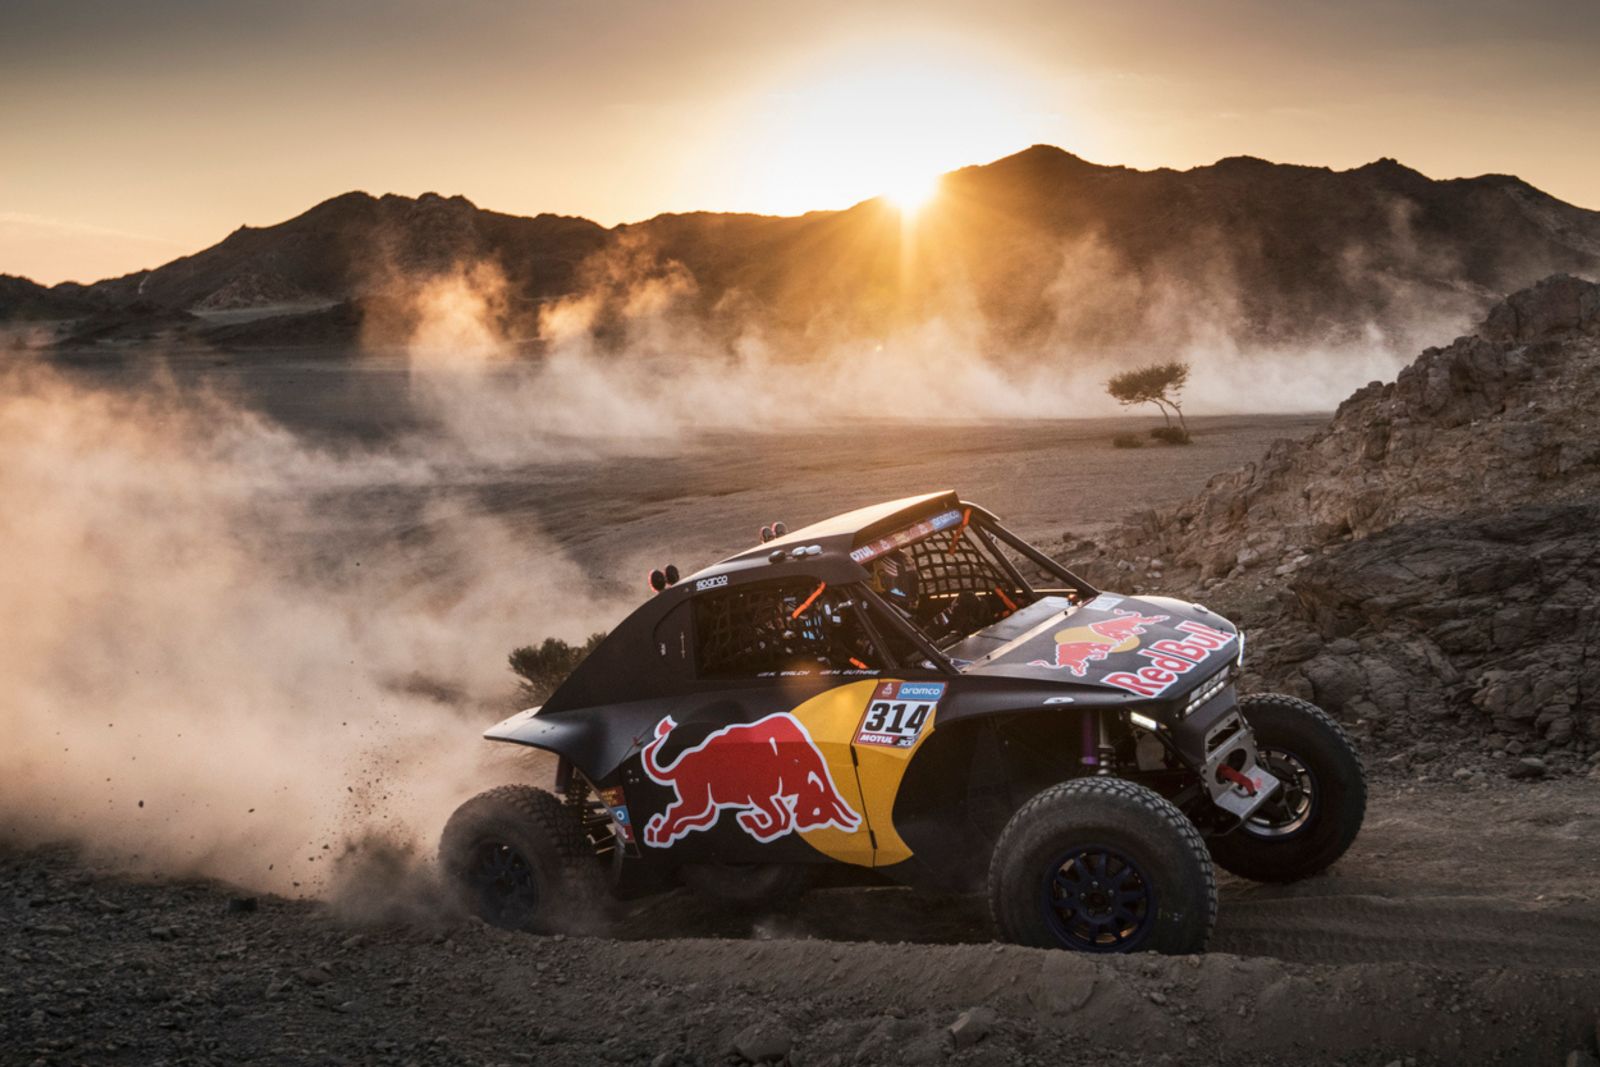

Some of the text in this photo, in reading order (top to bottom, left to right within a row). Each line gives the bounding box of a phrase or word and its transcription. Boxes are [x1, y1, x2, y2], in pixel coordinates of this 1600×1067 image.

[696, 575, 728, 591] sparco
[901, 686, 941, 696] aramco
[864, 702, 930, 735] 314
[859, 734, 894, 744] MOTUL
